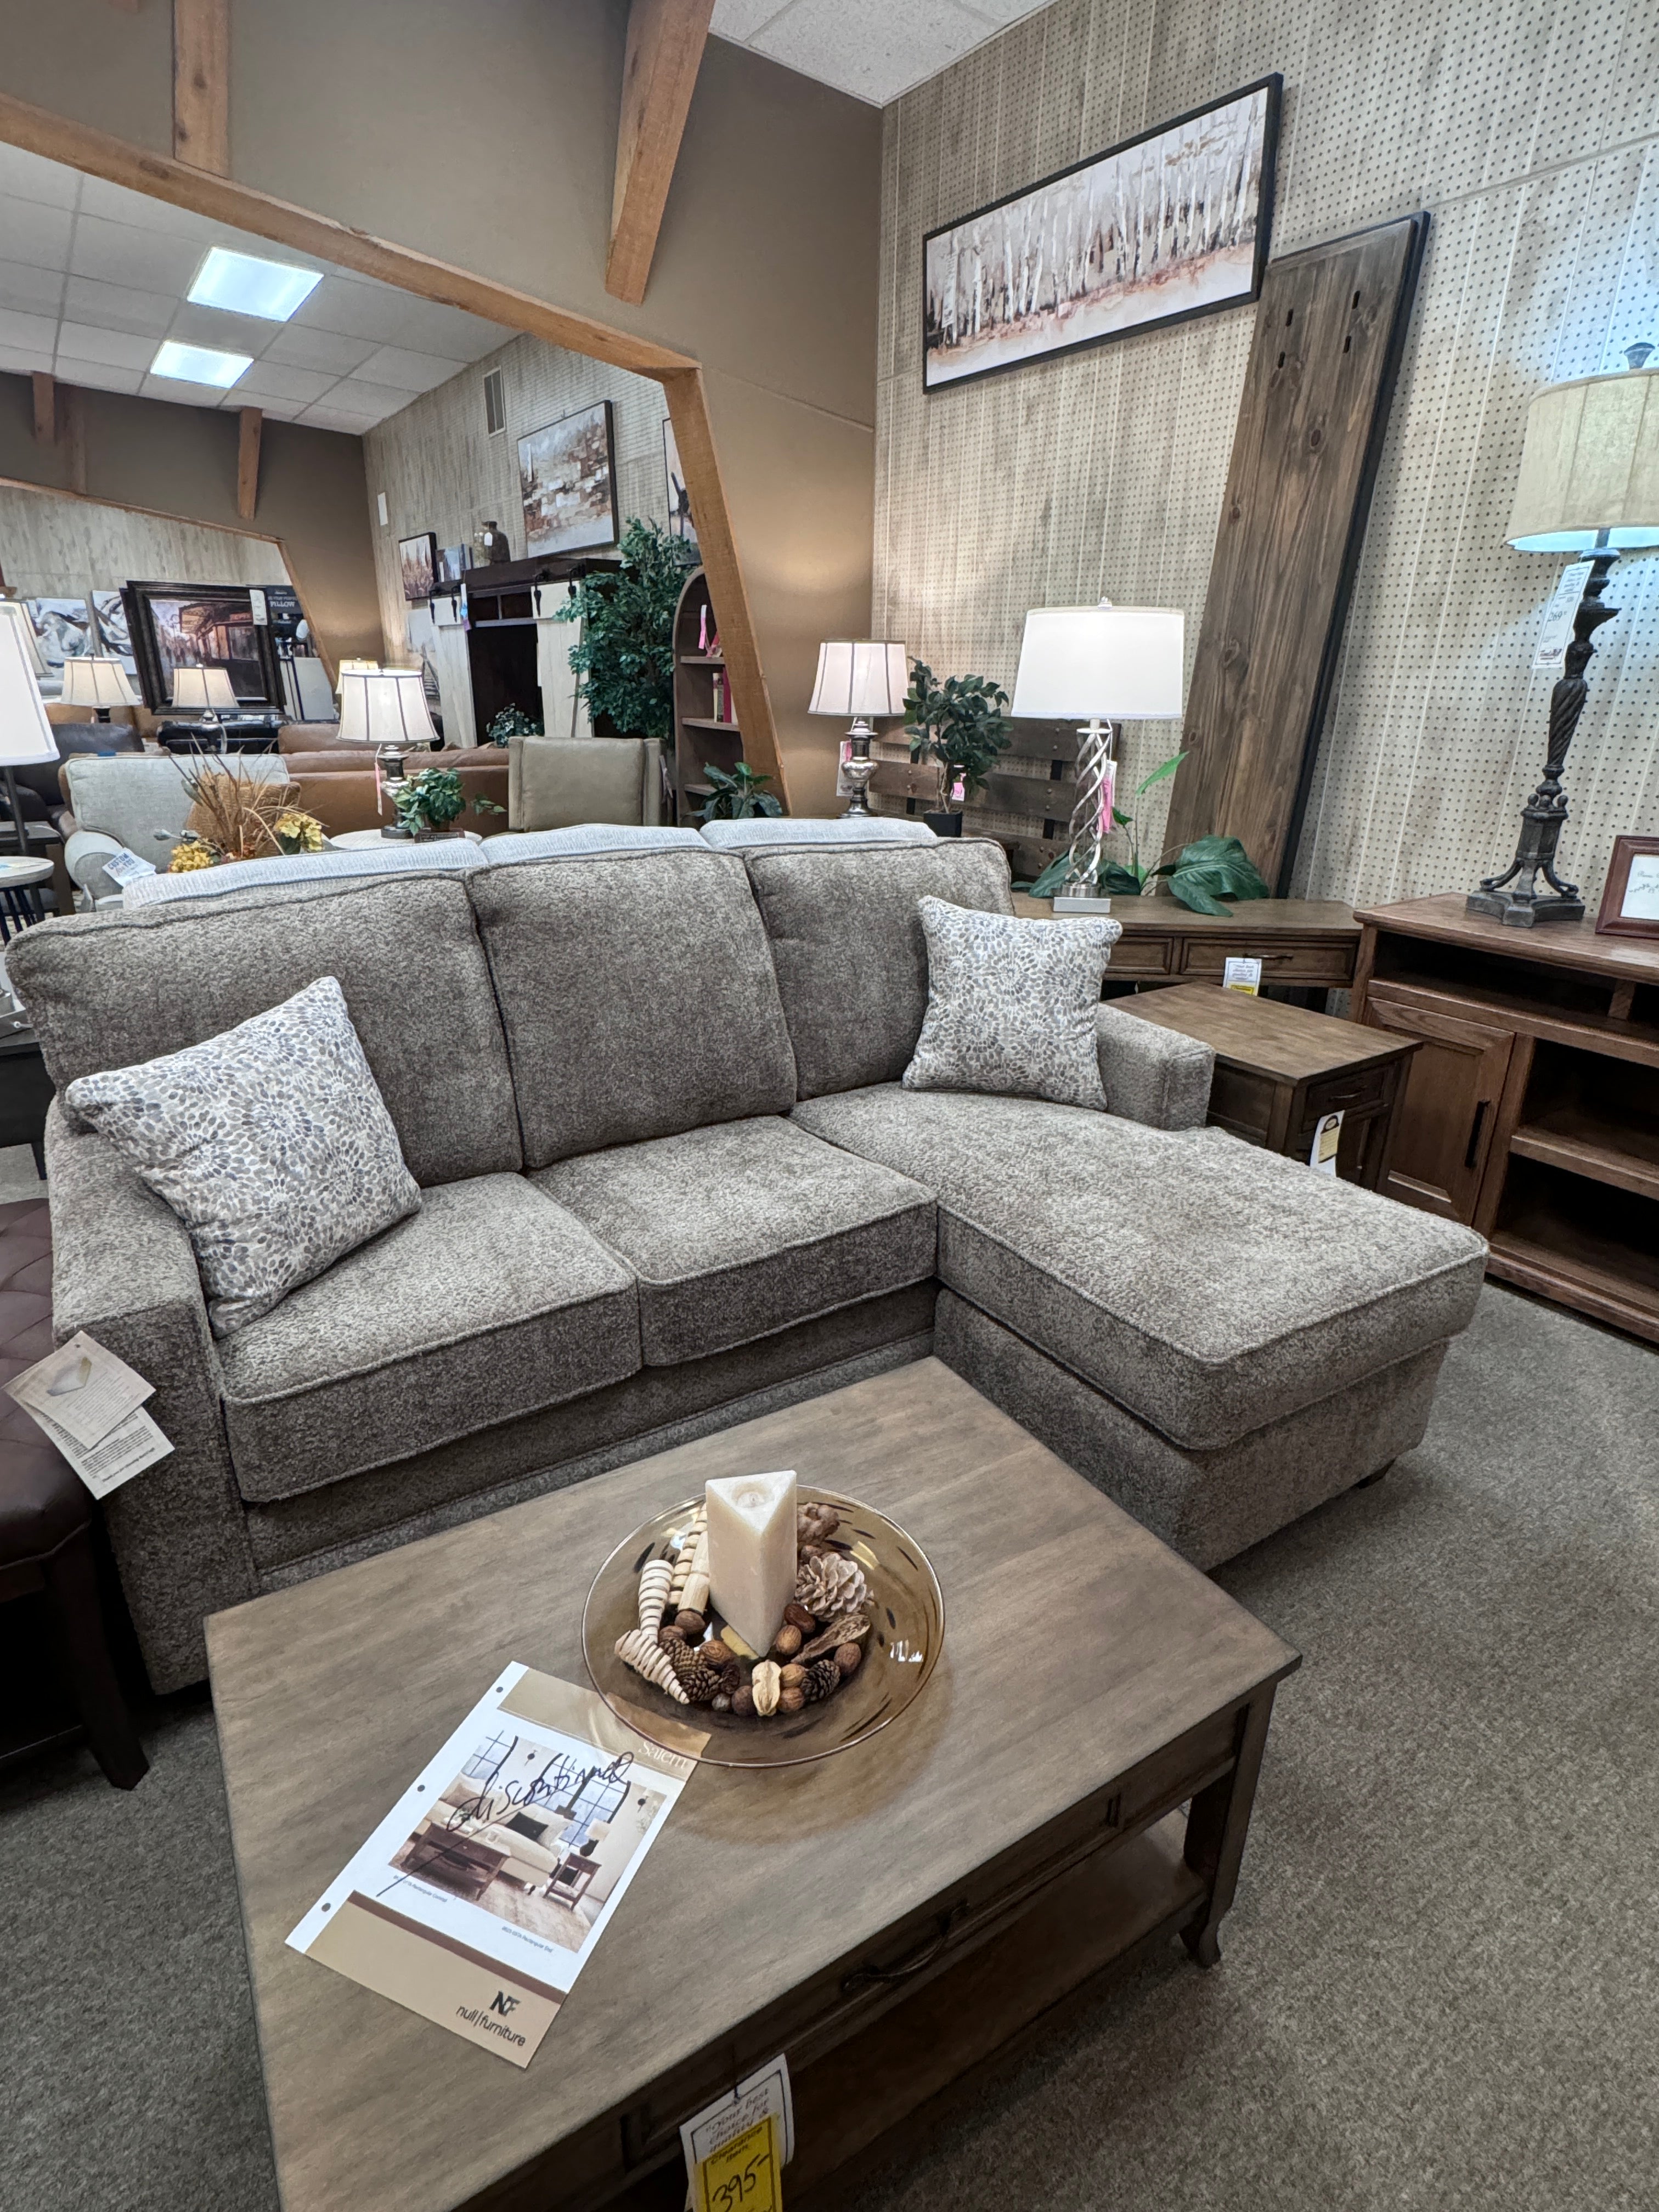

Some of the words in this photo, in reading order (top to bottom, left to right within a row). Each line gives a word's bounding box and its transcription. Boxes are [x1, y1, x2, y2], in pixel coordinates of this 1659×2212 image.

[108, 853, 129, 869] CUSTOM
[123, 858, 135, 868] YOU
[638, 1741, 686, 1769] Salem
[745, 2088, 769, 2109] best
[709, 2114, 750, 2145] choice
[752, 2098, 768, 2115] for
